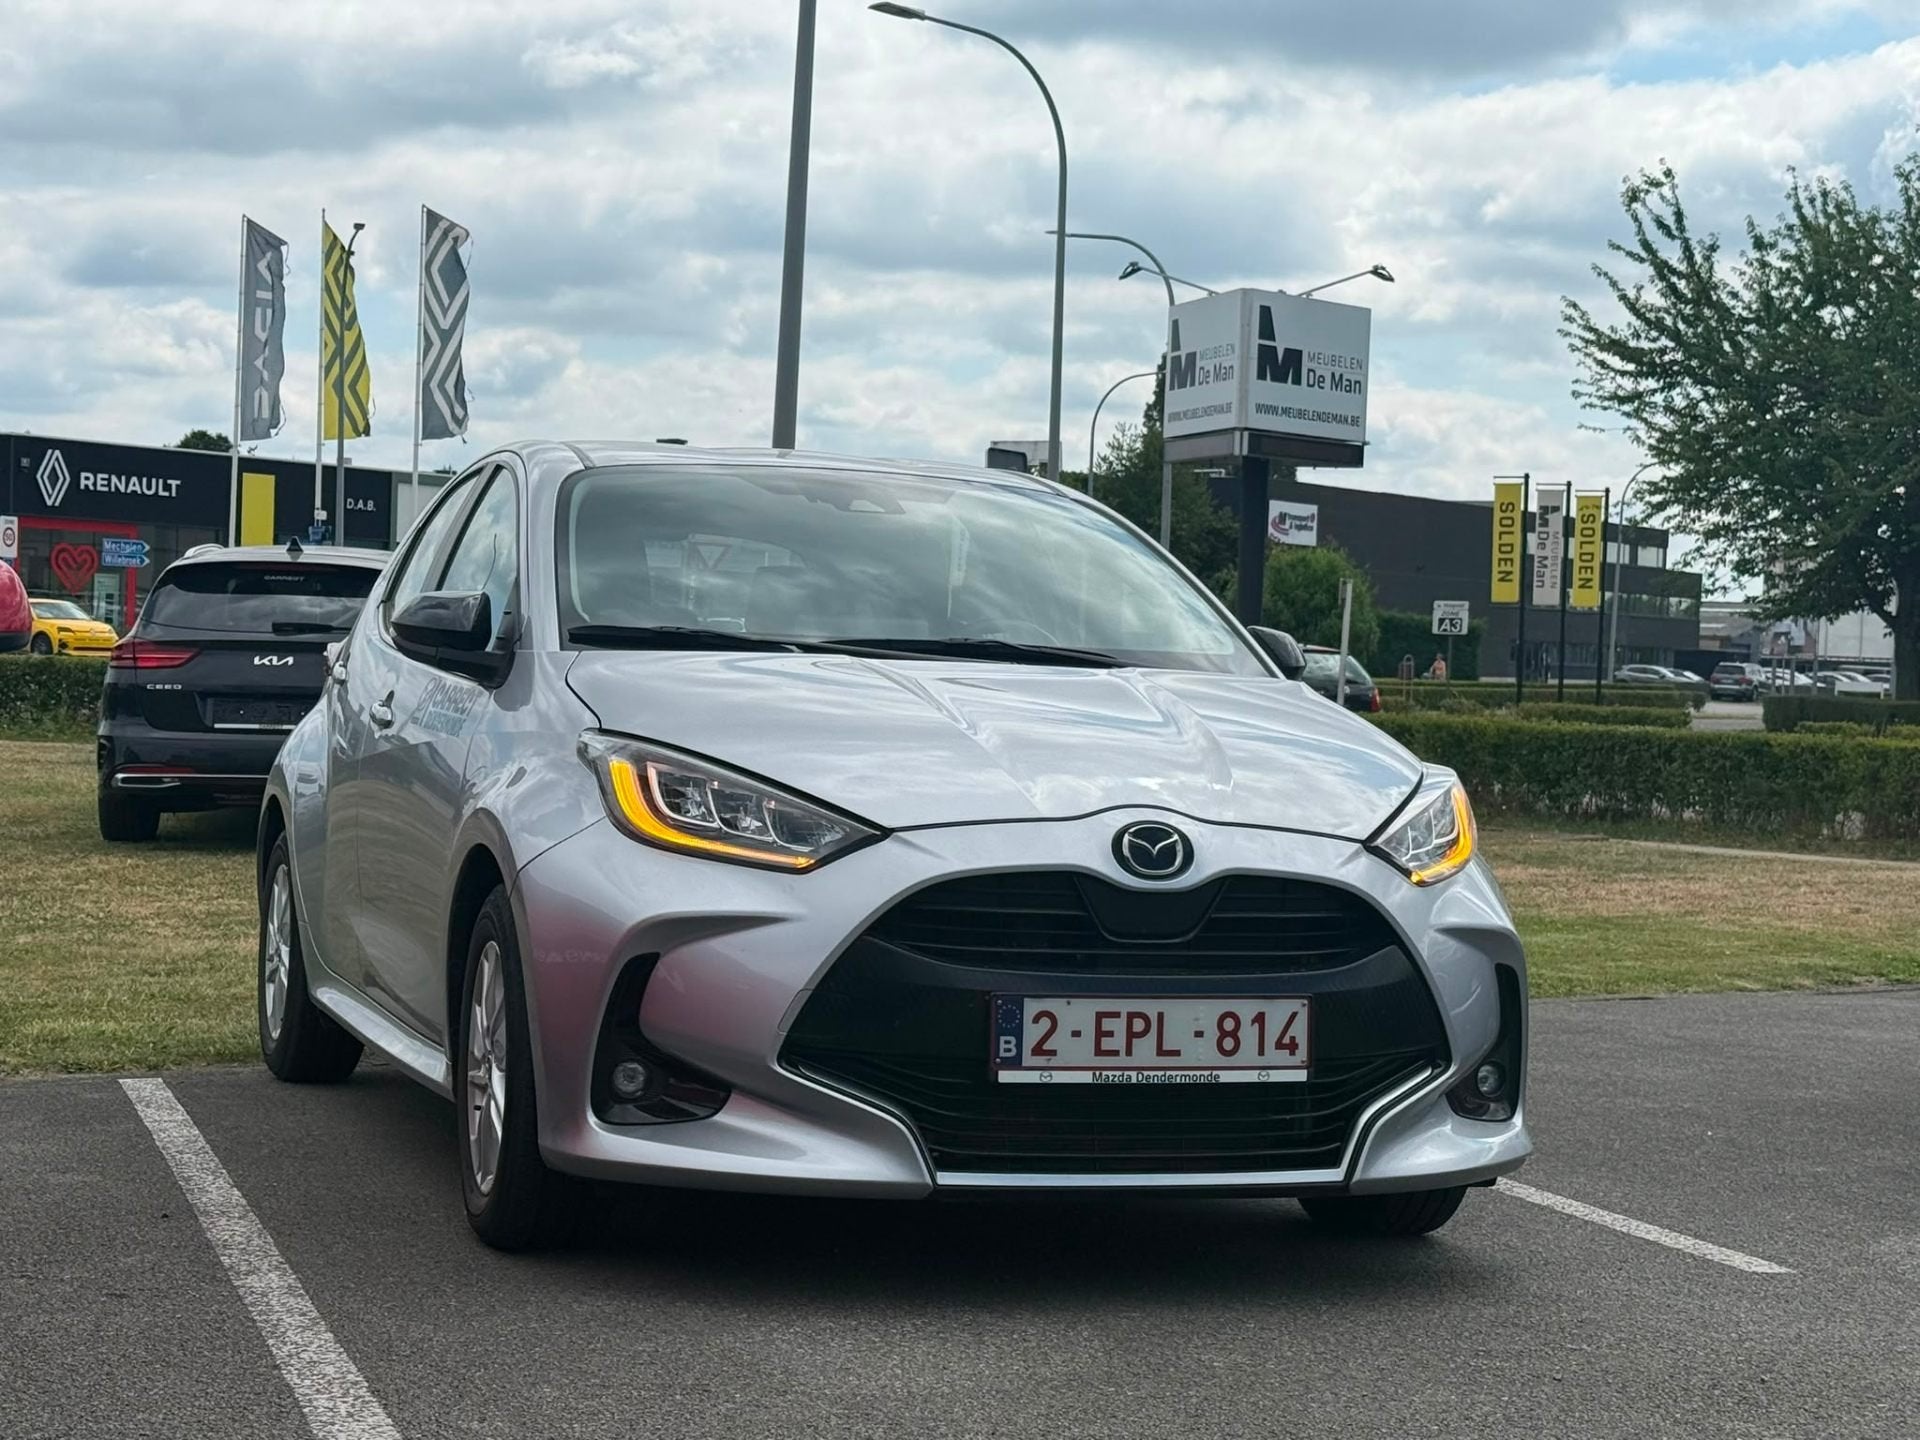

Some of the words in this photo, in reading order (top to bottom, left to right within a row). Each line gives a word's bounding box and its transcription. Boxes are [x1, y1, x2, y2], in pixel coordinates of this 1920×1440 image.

[1200, 343, 1235, 361] MEUBELEN
[1307, 350, 1363, 371] MEUBELEN
[1198, 366, 1211, 386] De
[1212, 362, 1234, 383] Man
[1306, 368, 1326, 390] De
[1330, 373, 1362, 395] Man
[1255, 402, 1360, 427] WWW.MEUBELENDEMAN.BE
[79, 471, 181, 497] RENAULT
[346, 498, 377, 511] D.A.B.
[104, 540, 142, 553] Mechelen
[1497, 501, 1515, 583] SOLDEN
[1537, 531, 1550, 551] De
[1577, 513, 1596, 589] SOLDEN
[104, 554, 141, 565] Willebroek
[1549, 530, 1560, 589] MEUBELEN
[1535, 556, 1549, 588] Man
[1439, 618, 1461, 632] A3
[1030, 1010, 1299, 1057] 2-EPL-814
[999, 1036, 1017, 1057] B
[1091, 1071, 1132, 1083] Mazda
[1136, 1071, 1221, 1083] Dendermonde
